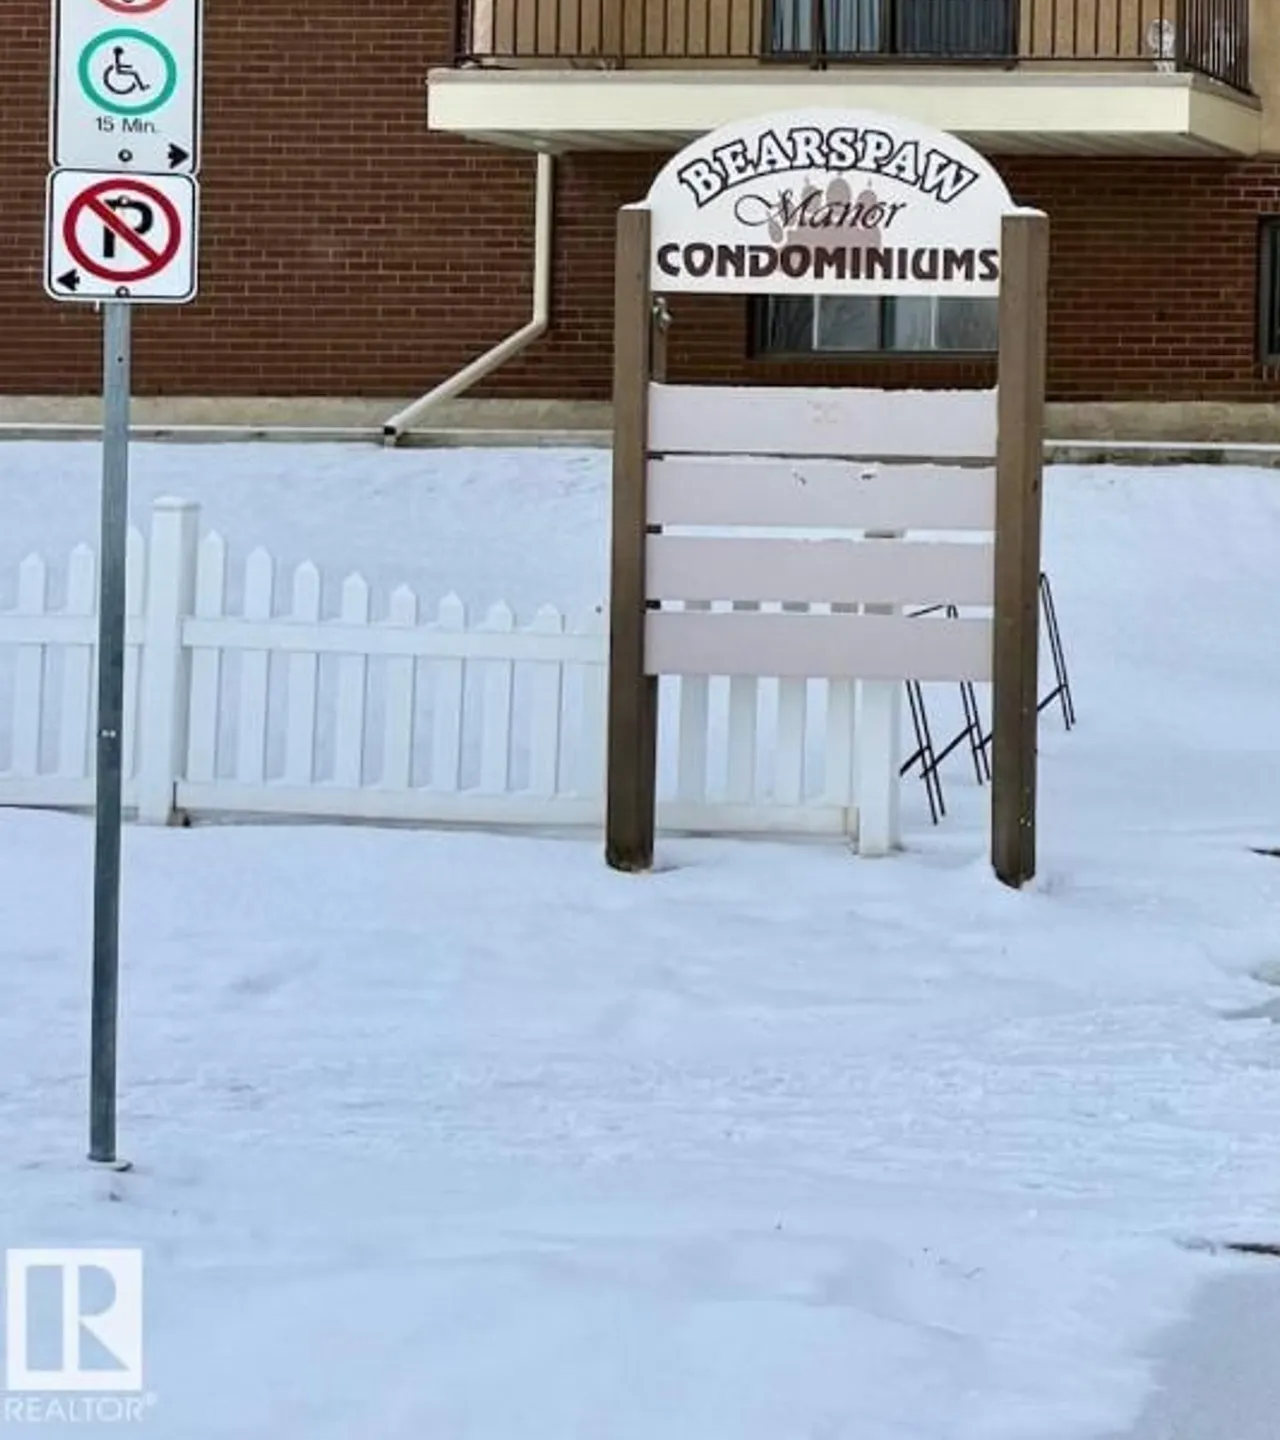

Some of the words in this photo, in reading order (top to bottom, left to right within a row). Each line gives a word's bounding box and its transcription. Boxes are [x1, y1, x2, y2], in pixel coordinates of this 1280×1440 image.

[96, 116, 115, 133] 15
[678, 128, 979, 208] BEARSPAW
[733, 184, 908, 231] Manor
[656, 241, 999, 282] CONDOMINIUMS
